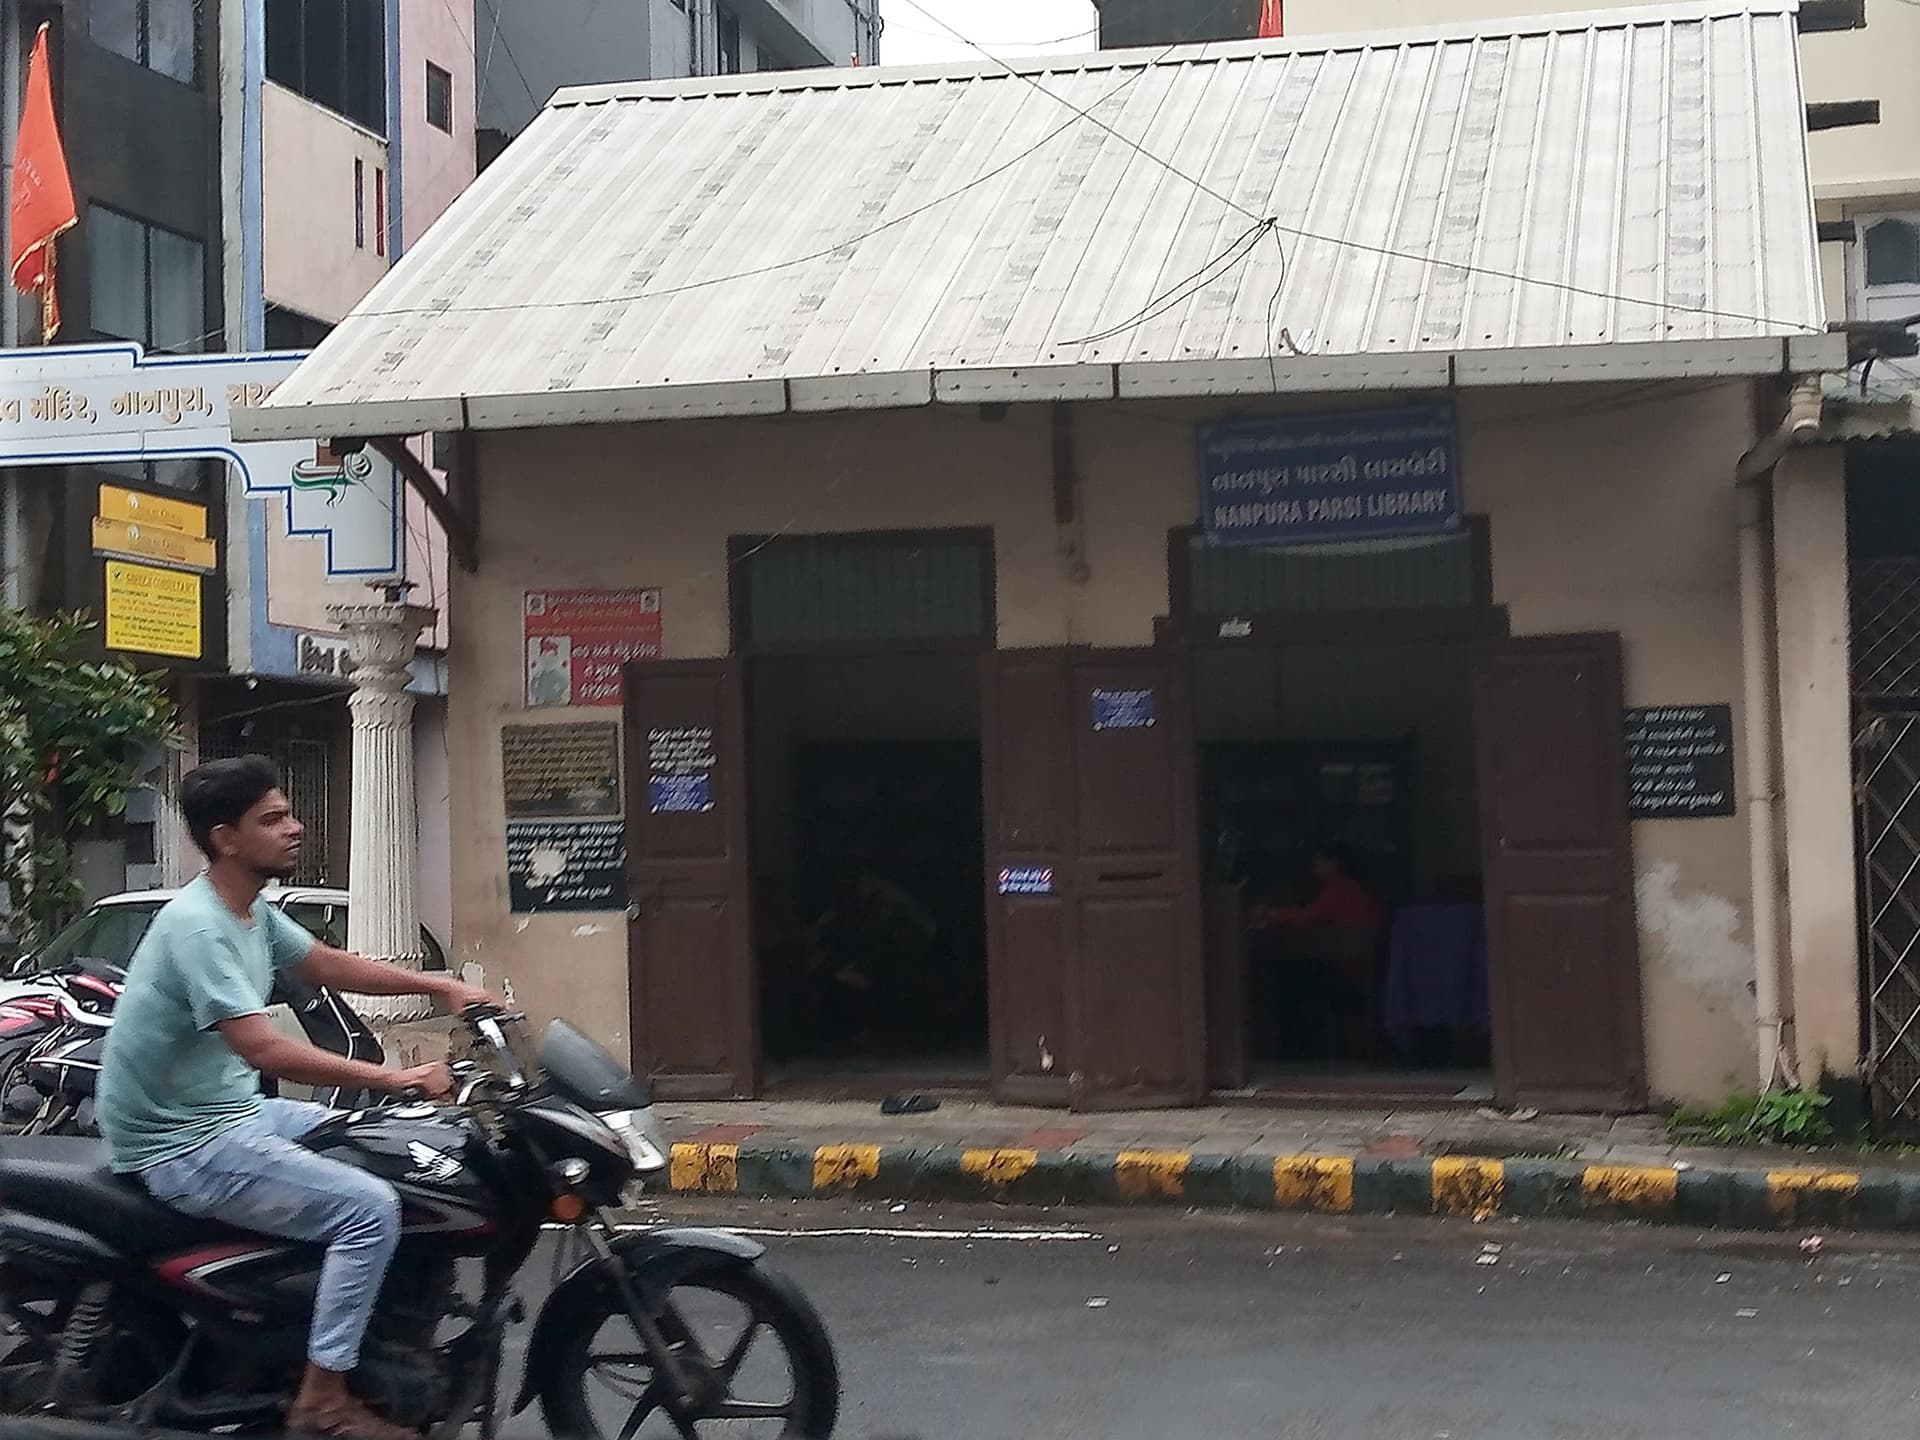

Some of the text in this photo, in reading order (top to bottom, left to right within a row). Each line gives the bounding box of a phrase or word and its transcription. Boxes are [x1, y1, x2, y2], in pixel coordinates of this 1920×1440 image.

[30, 384, 98, 425] મંદિર,
[110, 385, 215, 425] નાનપુરા,
[1214, 489, 1448, 528] NANPURA PARSI LIBRARY
